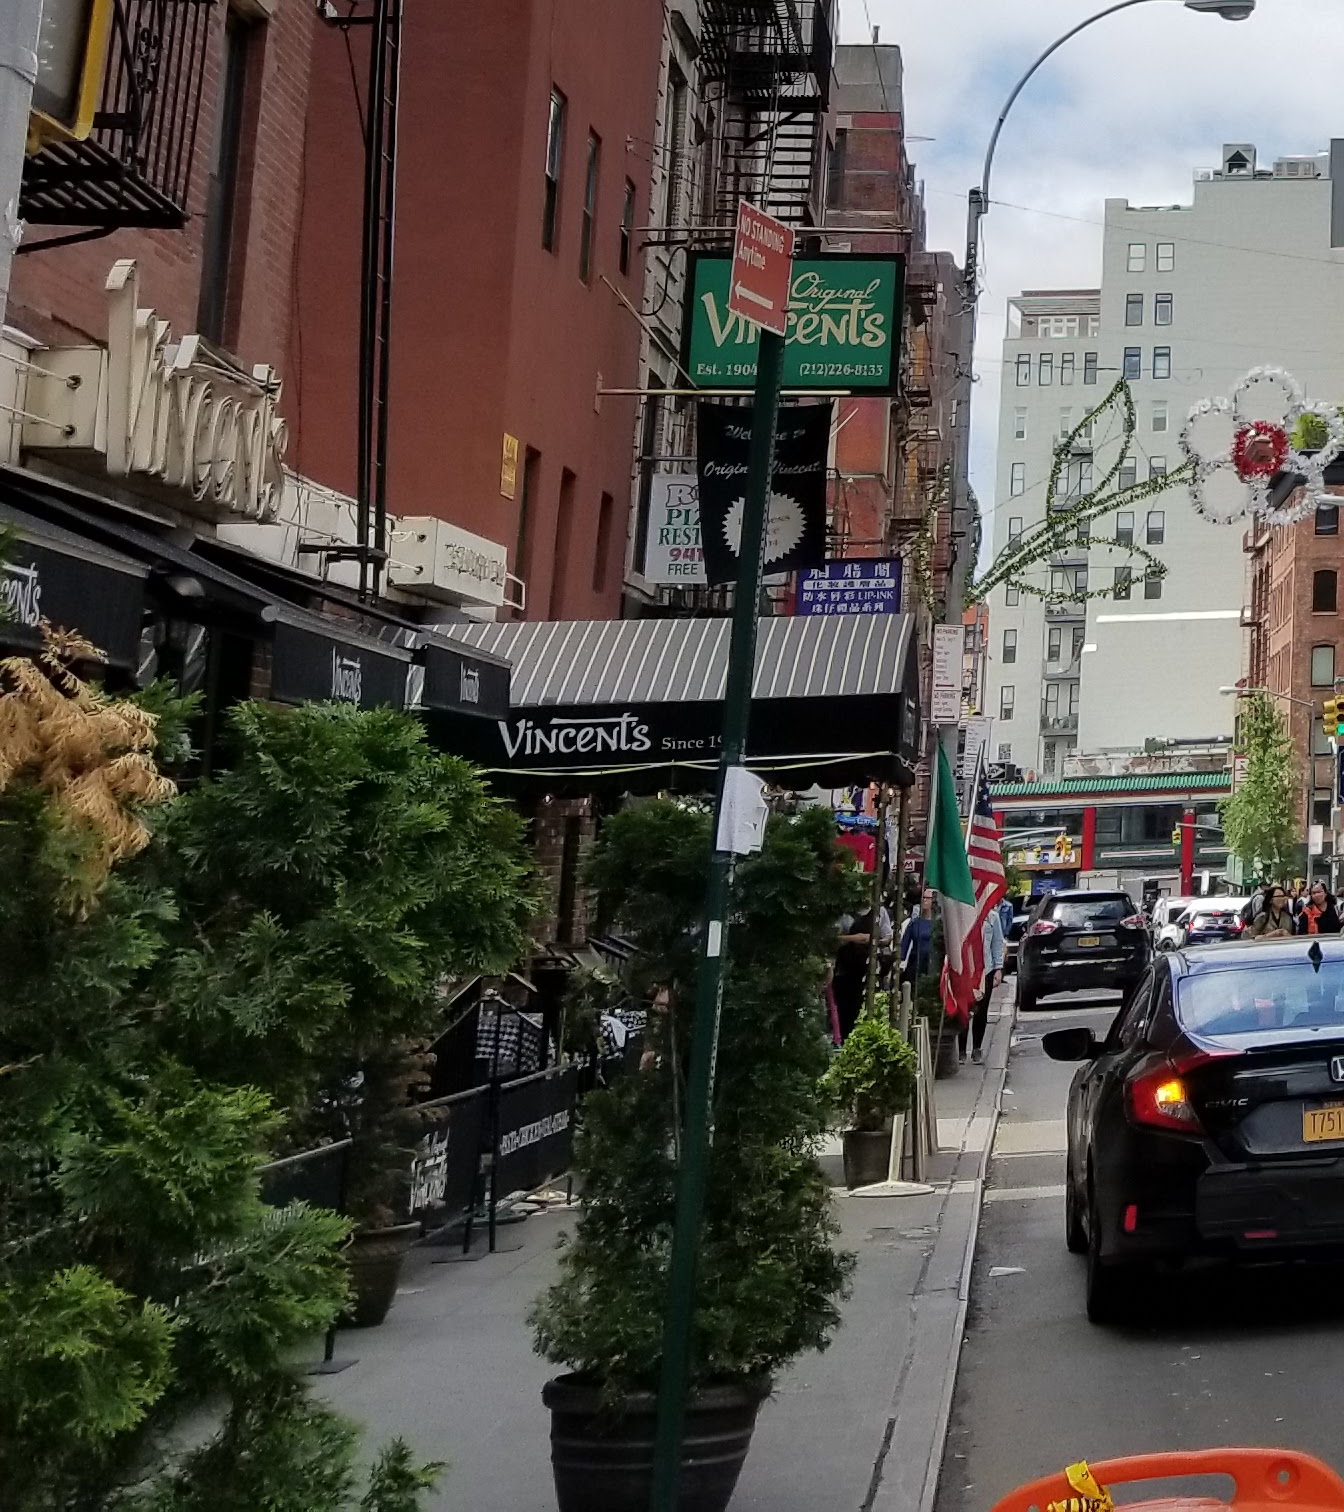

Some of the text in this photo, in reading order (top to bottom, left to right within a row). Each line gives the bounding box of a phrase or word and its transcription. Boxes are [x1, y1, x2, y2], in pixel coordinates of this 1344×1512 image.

[740, 214, 785, 254] NO STANDING
[738, 241, 766, 270] Anytime
[791, 272, 881, 312] Original
[697, 364, 722, 376] Est.
[726, 364, 758, 376] 1904
[704, 461, 750, 480] Origin
[667, 564, 698, 576] FREE
[498, 712, 651, 759] Vincent's
[661, 736, 705, 751] Since
[1204, 1098, 1249, 1108] CIVIC
